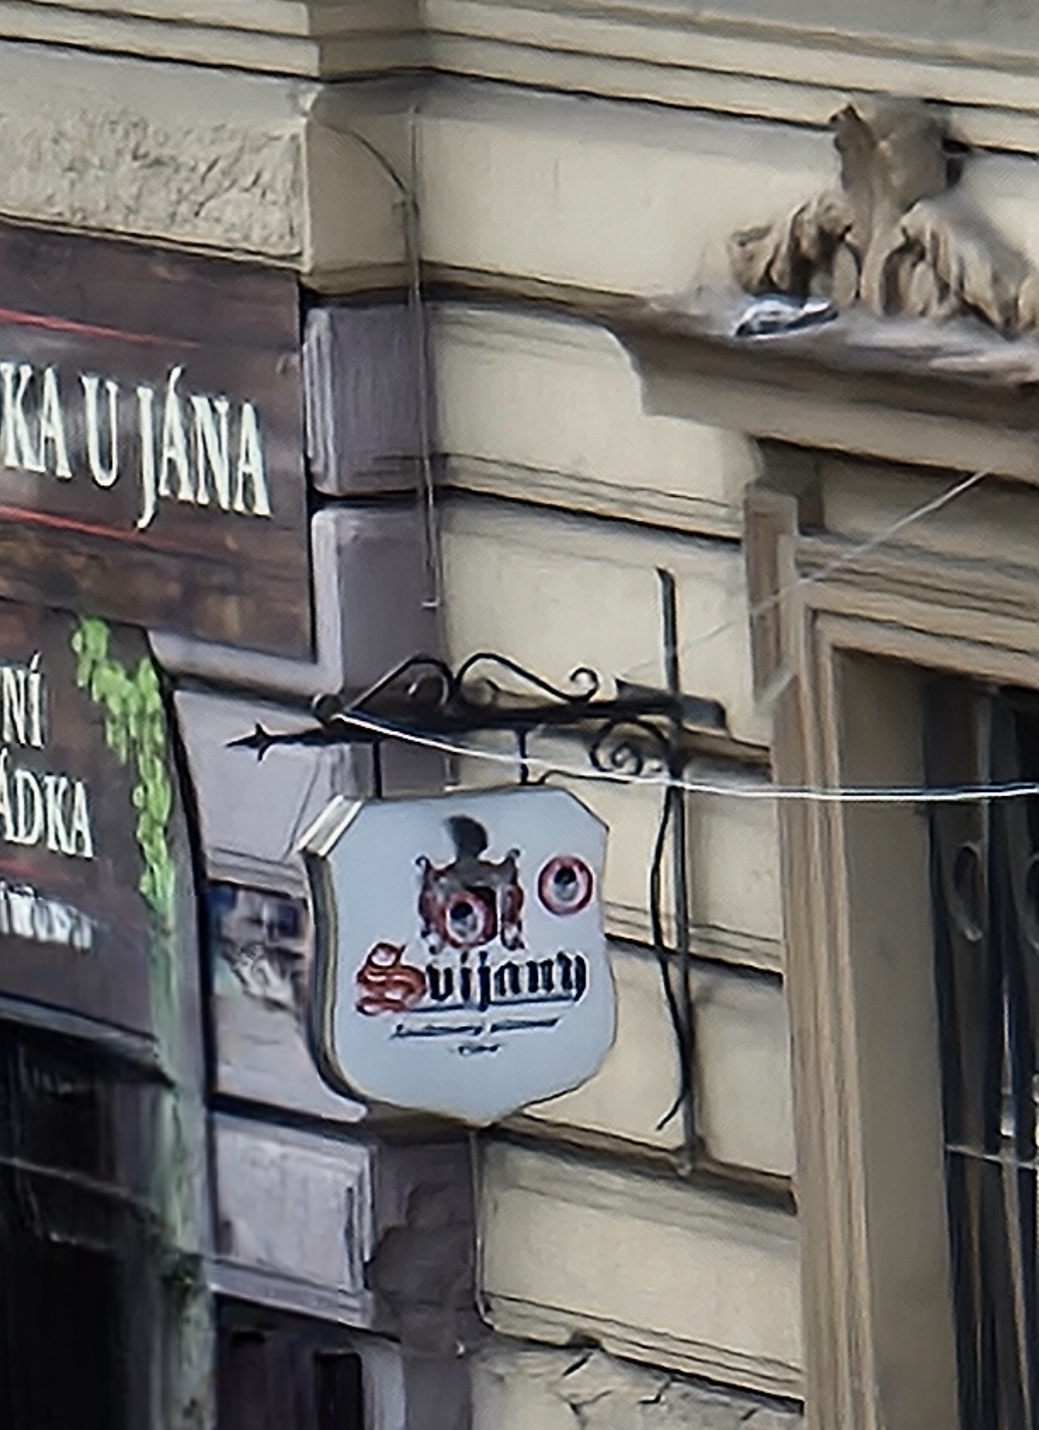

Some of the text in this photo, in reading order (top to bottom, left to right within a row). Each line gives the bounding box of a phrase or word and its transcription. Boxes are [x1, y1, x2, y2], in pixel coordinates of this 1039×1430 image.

[81, 373, 120, 487] U
[136, 363, 273, 529] JÁNA
[356, 942, 589, 1015] Svijany
